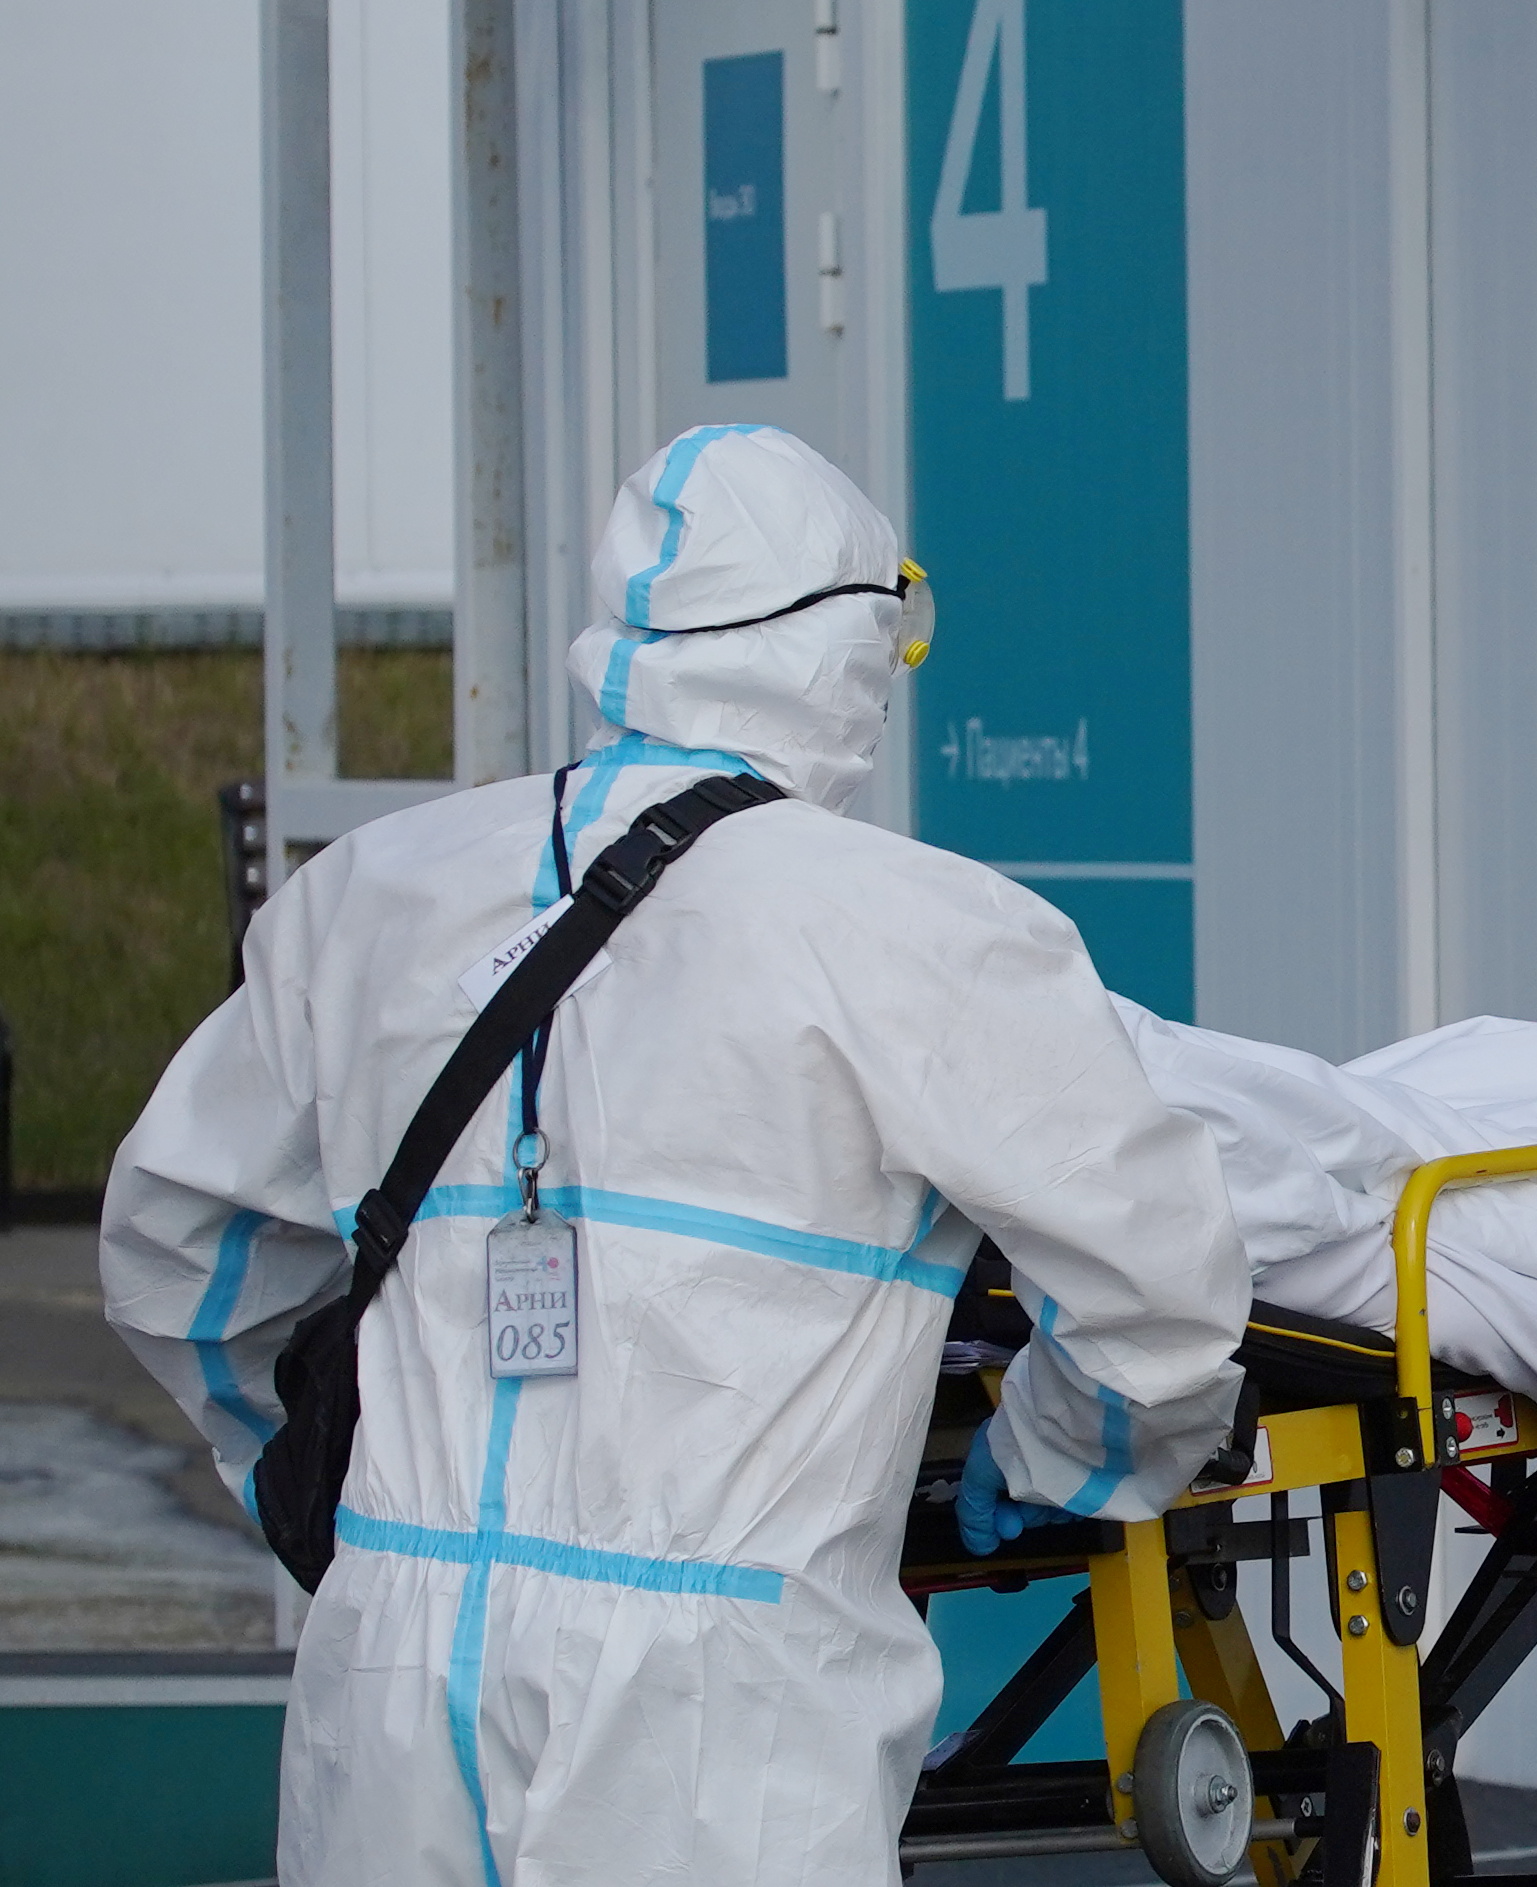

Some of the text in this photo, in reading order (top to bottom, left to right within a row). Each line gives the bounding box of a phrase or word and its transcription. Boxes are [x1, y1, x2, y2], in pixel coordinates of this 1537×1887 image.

[931, 0, 1048, 401] 4
[966, 717, 1089, 788] Пациенты 4
[497, 1320, 570, 1361] 085
